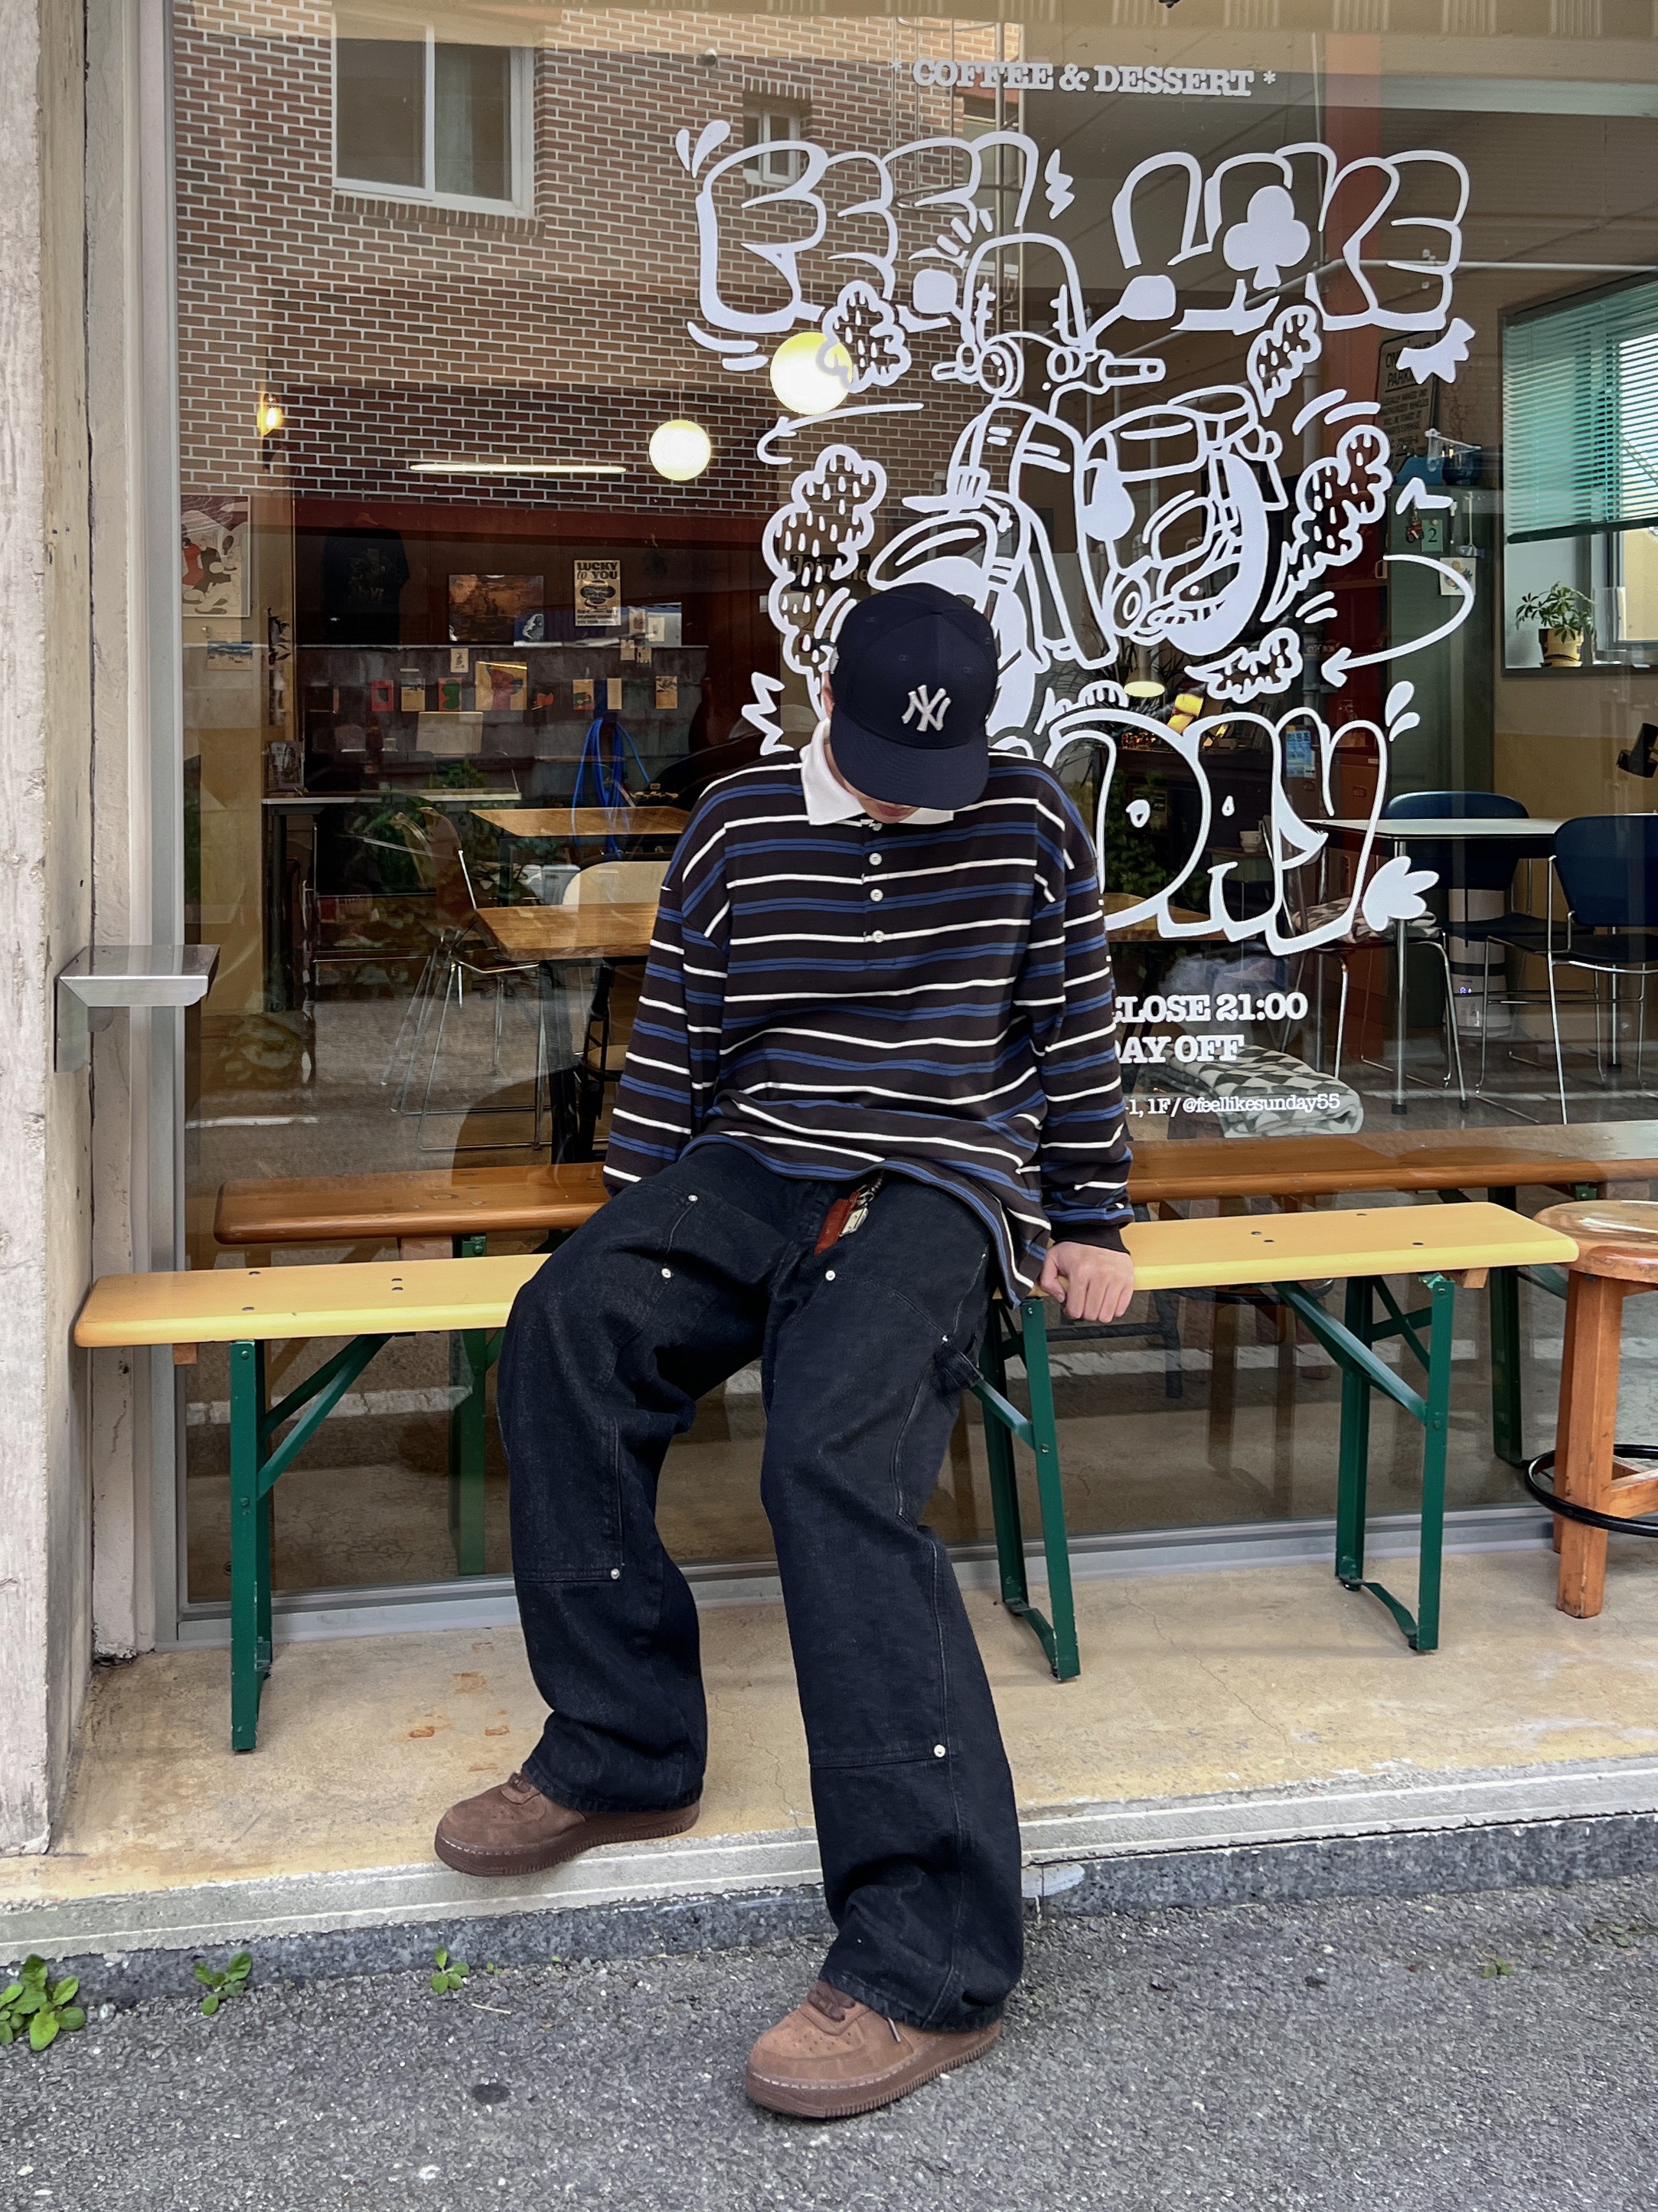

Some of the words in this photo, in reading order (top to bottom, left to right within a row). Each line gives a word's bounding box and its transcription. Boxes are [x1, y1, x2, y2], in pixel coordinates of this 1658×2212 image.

[913, 59, 1053, 90] COFFEE
[1059, 64, 1090, 92] &
[1094, 65, 1254, 96] DESSERT
[1428, 528, 1438, 543] 2
[576, 562, 618, 570] LUCKY
[592, 570, 618, 580] YOU
[901, 685, 951, 732] NY
[1215, 992, 1309, 1022] 21:00
[1115, 1035, 1172, 1064] AY
[1173, 1034, 1245, 1064] OFF
[1183, 1093, 1341, 1113] @feellikesunday55
